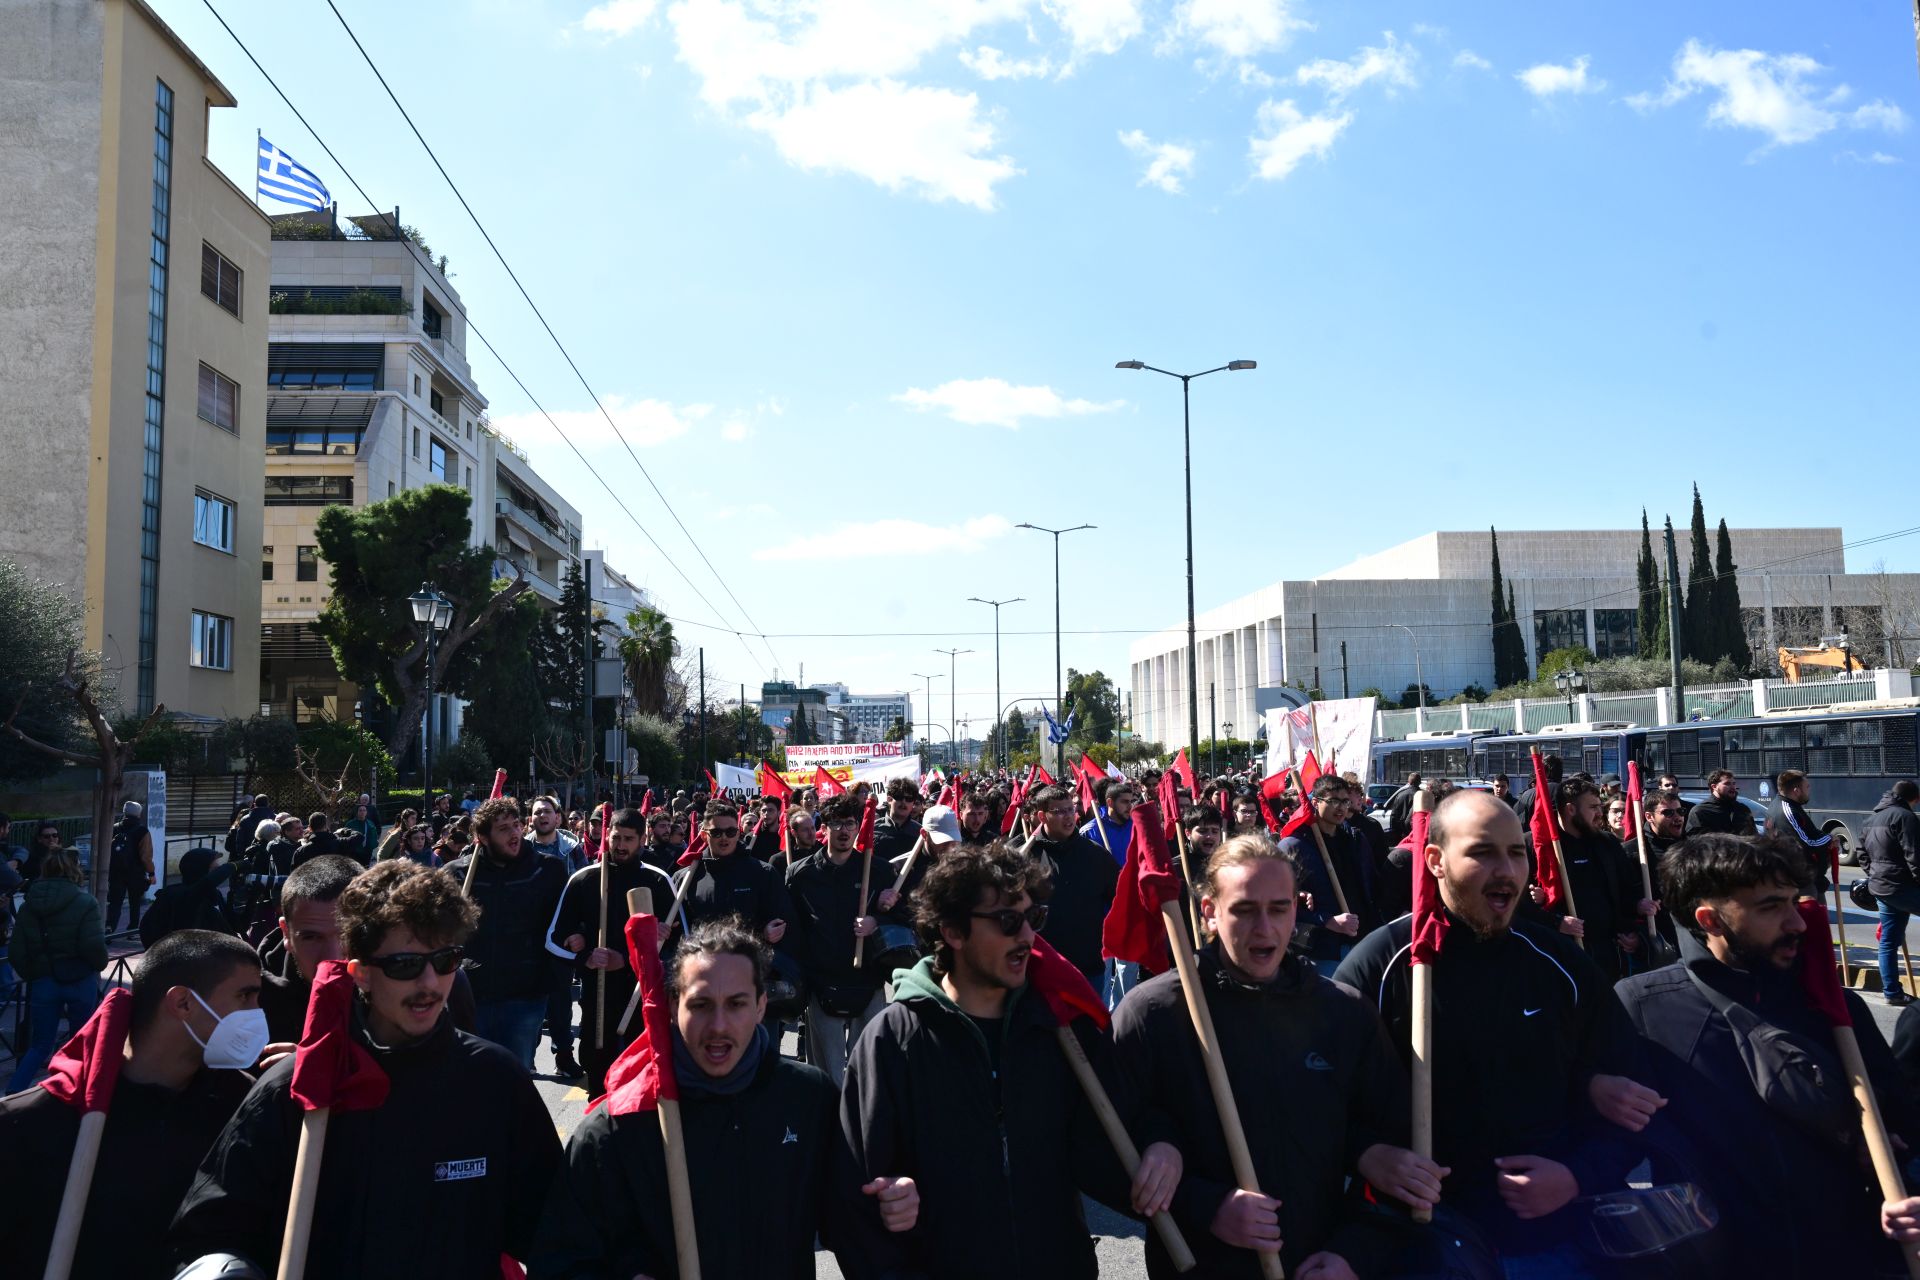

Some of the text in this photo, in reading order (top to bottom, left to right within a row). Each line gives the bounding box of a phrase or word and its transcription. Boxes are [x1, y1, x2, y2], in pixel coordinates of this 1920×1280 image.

[786, 746, 804, 756] ΚΑΤΩ
[830, 745, 844, 755] ΑΠΟ
[844, 745, 852, 755] ΤΟ
[855, 745, 870, 755] ΙΡΑΝ
[873, 742, 903, 757] ΟΚΔΕ
[450, 1160, 485, 1173] MUERTE
